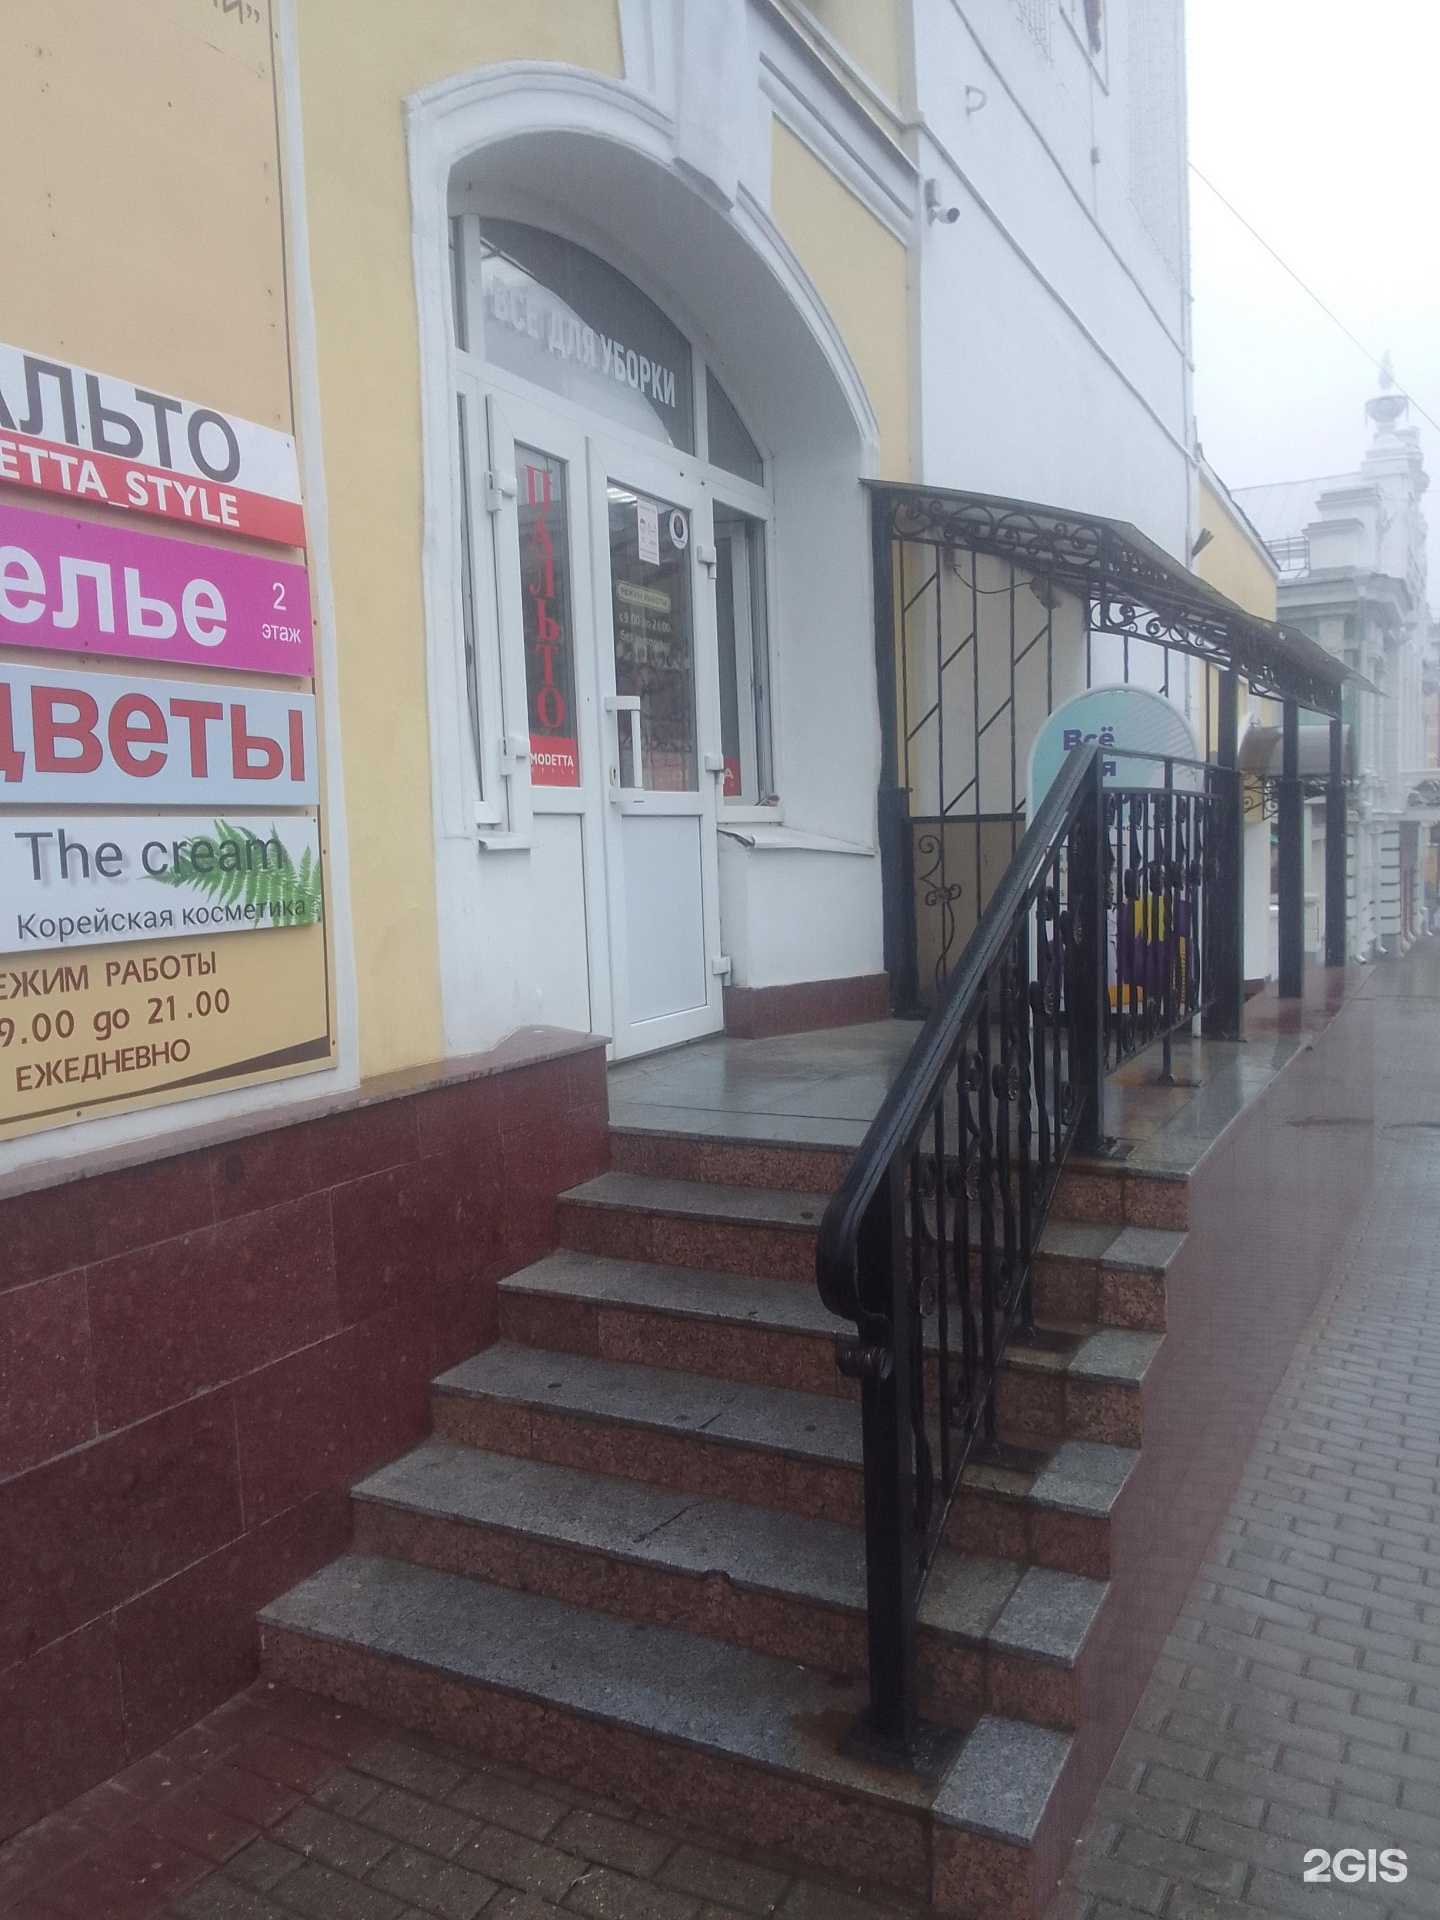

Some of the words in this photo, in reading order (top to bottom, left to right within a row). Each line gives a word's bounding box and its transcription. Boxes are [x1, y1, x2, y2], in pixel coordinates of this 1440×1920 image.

[600, 333, 676, 408] УБОРКИ
[272, 583, 287, 611] 2
[262, 623, 301, 644] этаж
[530, 752, 574, 767] MODETTA
[15, 829, 123, 881] The
[141, 835, 284, 876] cream
[17, 908, 173, 942] Корейская
[182, 900, 306, 926] косметика
[105, 950, 217, 987] РАБОТЫ
[147, 988, 231, 1026] 21.00
[15, 1038, 191, 1092] ЕЖЕДНЕВНО
